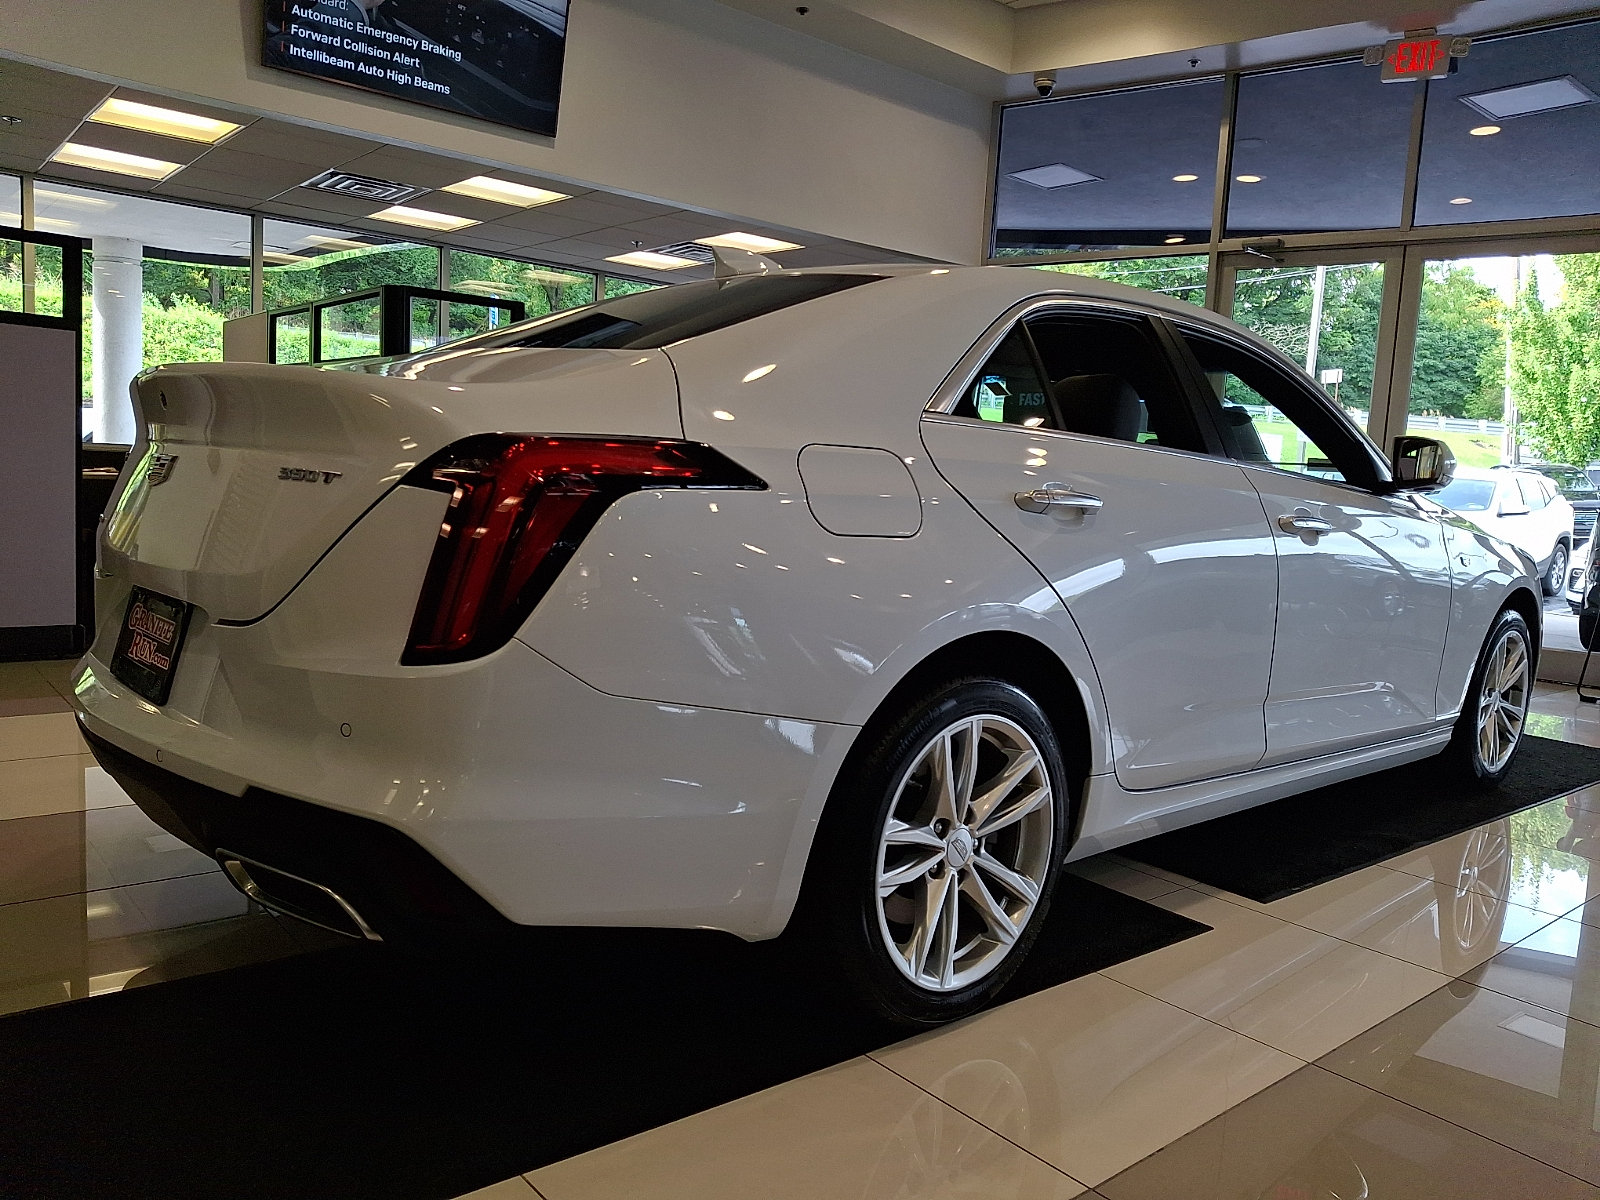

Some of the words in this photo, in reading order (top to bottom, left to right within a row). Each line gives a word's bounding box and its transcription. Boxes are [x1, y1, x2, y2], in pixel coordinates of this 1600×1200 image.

[290, 24, 341, 47] Forward
[343, 38, 391, 60] Collision
[393, 52, 420, 69] Alert
[291, 4, 354, 31] Automatic
[356, 22, 419, 50] Emergency
[421, 39, 462, 62] Braking
[1395, 40, 1441, 74] EXIT
[289, 44, 355, 71] Intellibeam
[357, 62, 385, 78] Auto
[386, 69, 412, 86] High
[414, 76, 451, 95] Beams
